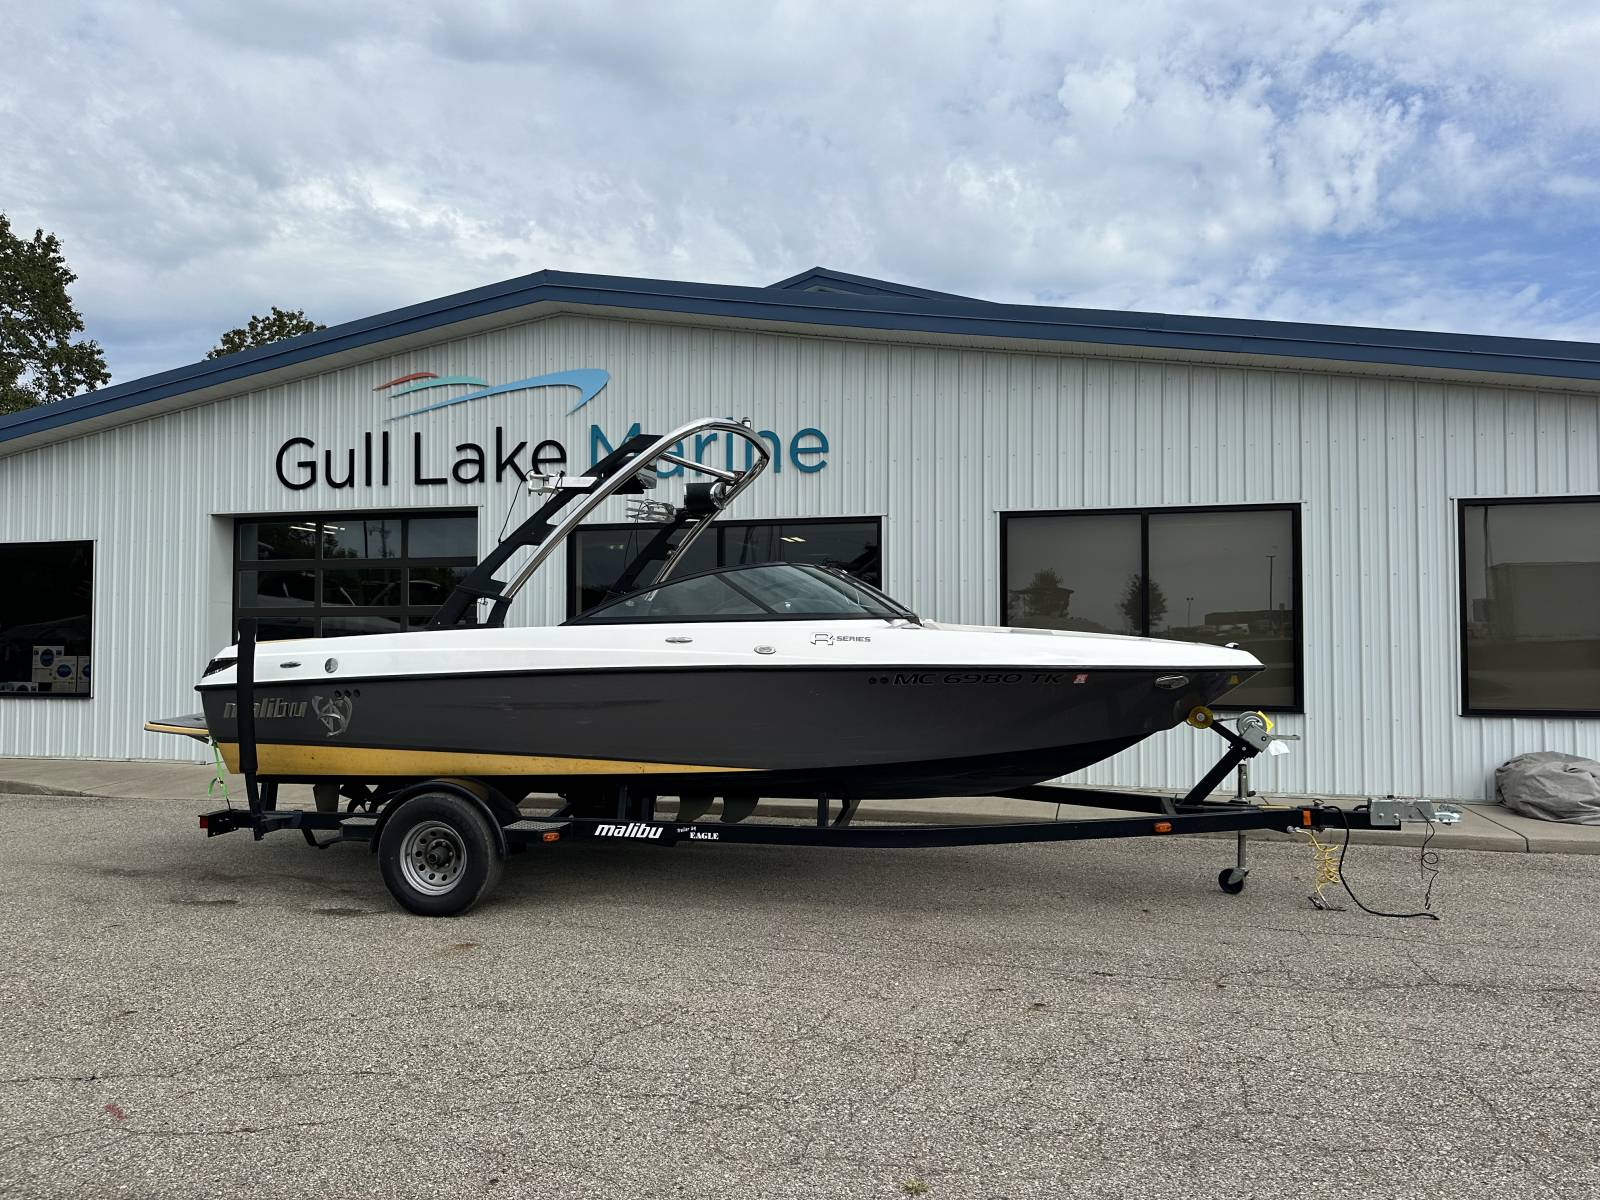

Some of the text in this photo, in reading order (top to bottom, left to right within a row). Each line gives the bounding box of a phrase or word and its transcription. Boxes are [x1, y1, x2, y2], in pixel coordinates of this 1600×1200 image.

[276, 416, 829, 490] Gull Lake Marine
[836, 635, 871, 643] SERIES
[893, 672, 937, 685] MC
[943, 673, 1023, 685] 6980
[1031, 674, 1065, 684] TK
[594, 822, 664, 839] malibu
[689, 831, 719, 840] EAGLE
